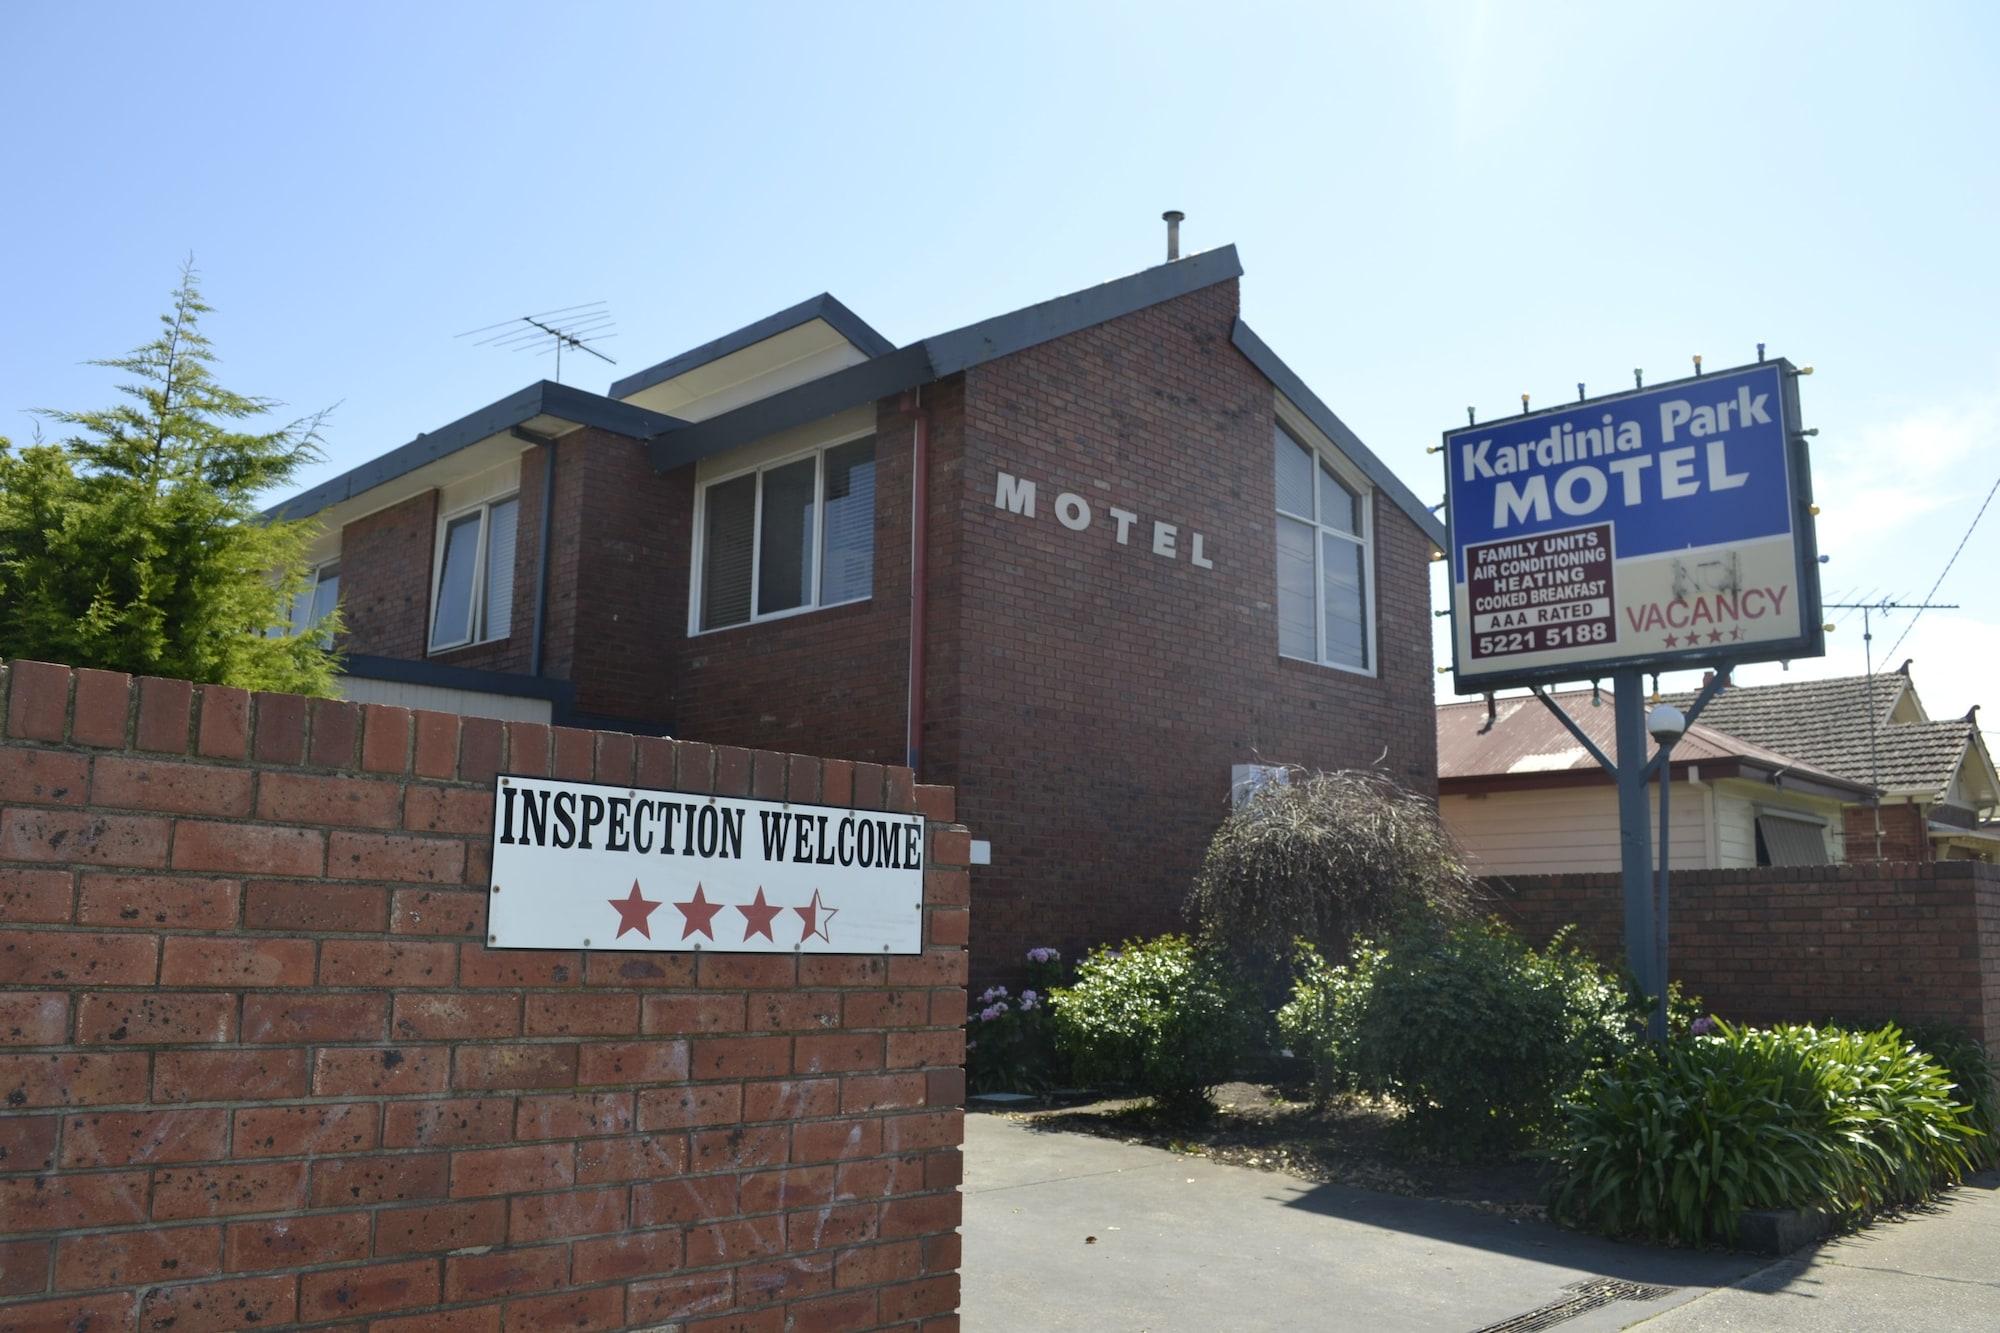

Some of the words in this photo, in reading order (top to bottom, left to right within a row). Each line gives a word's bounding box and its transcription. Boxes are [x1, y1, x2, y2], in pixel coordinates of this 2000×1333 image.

[1462, 414, 1642, 481] Kardinia
[1659, 386, 1773, 443] Park
[1492, 440, 1750, 529] MOTEL
[994, 471, 1213, 569] MOTEL
[1473, 565, 1497, 580] AIR
[1500, 547, 1606, 577] CONDITIONING
[1478, 541, 1538, 564] FAMILY
[1543, 531, 1599, 553] UNITS
[1476, 592, 1527, 611] COOKED
[1530, 580, 1606, 604] BREAKFAST
[1494, 567, 1585, 593] HEATING
[1490, 612, 1528, 629] AAA
[1538, 603, 1593, 623] RATED
[1625, 585, 1788, 633] VACANCY
[1479, 631, 1536, 655] 5221
[1545, 622, 1608, 647] 5188
[499, 787, 746, 860] INSPECTION
[759, 810, 922, 871] WELCOME
